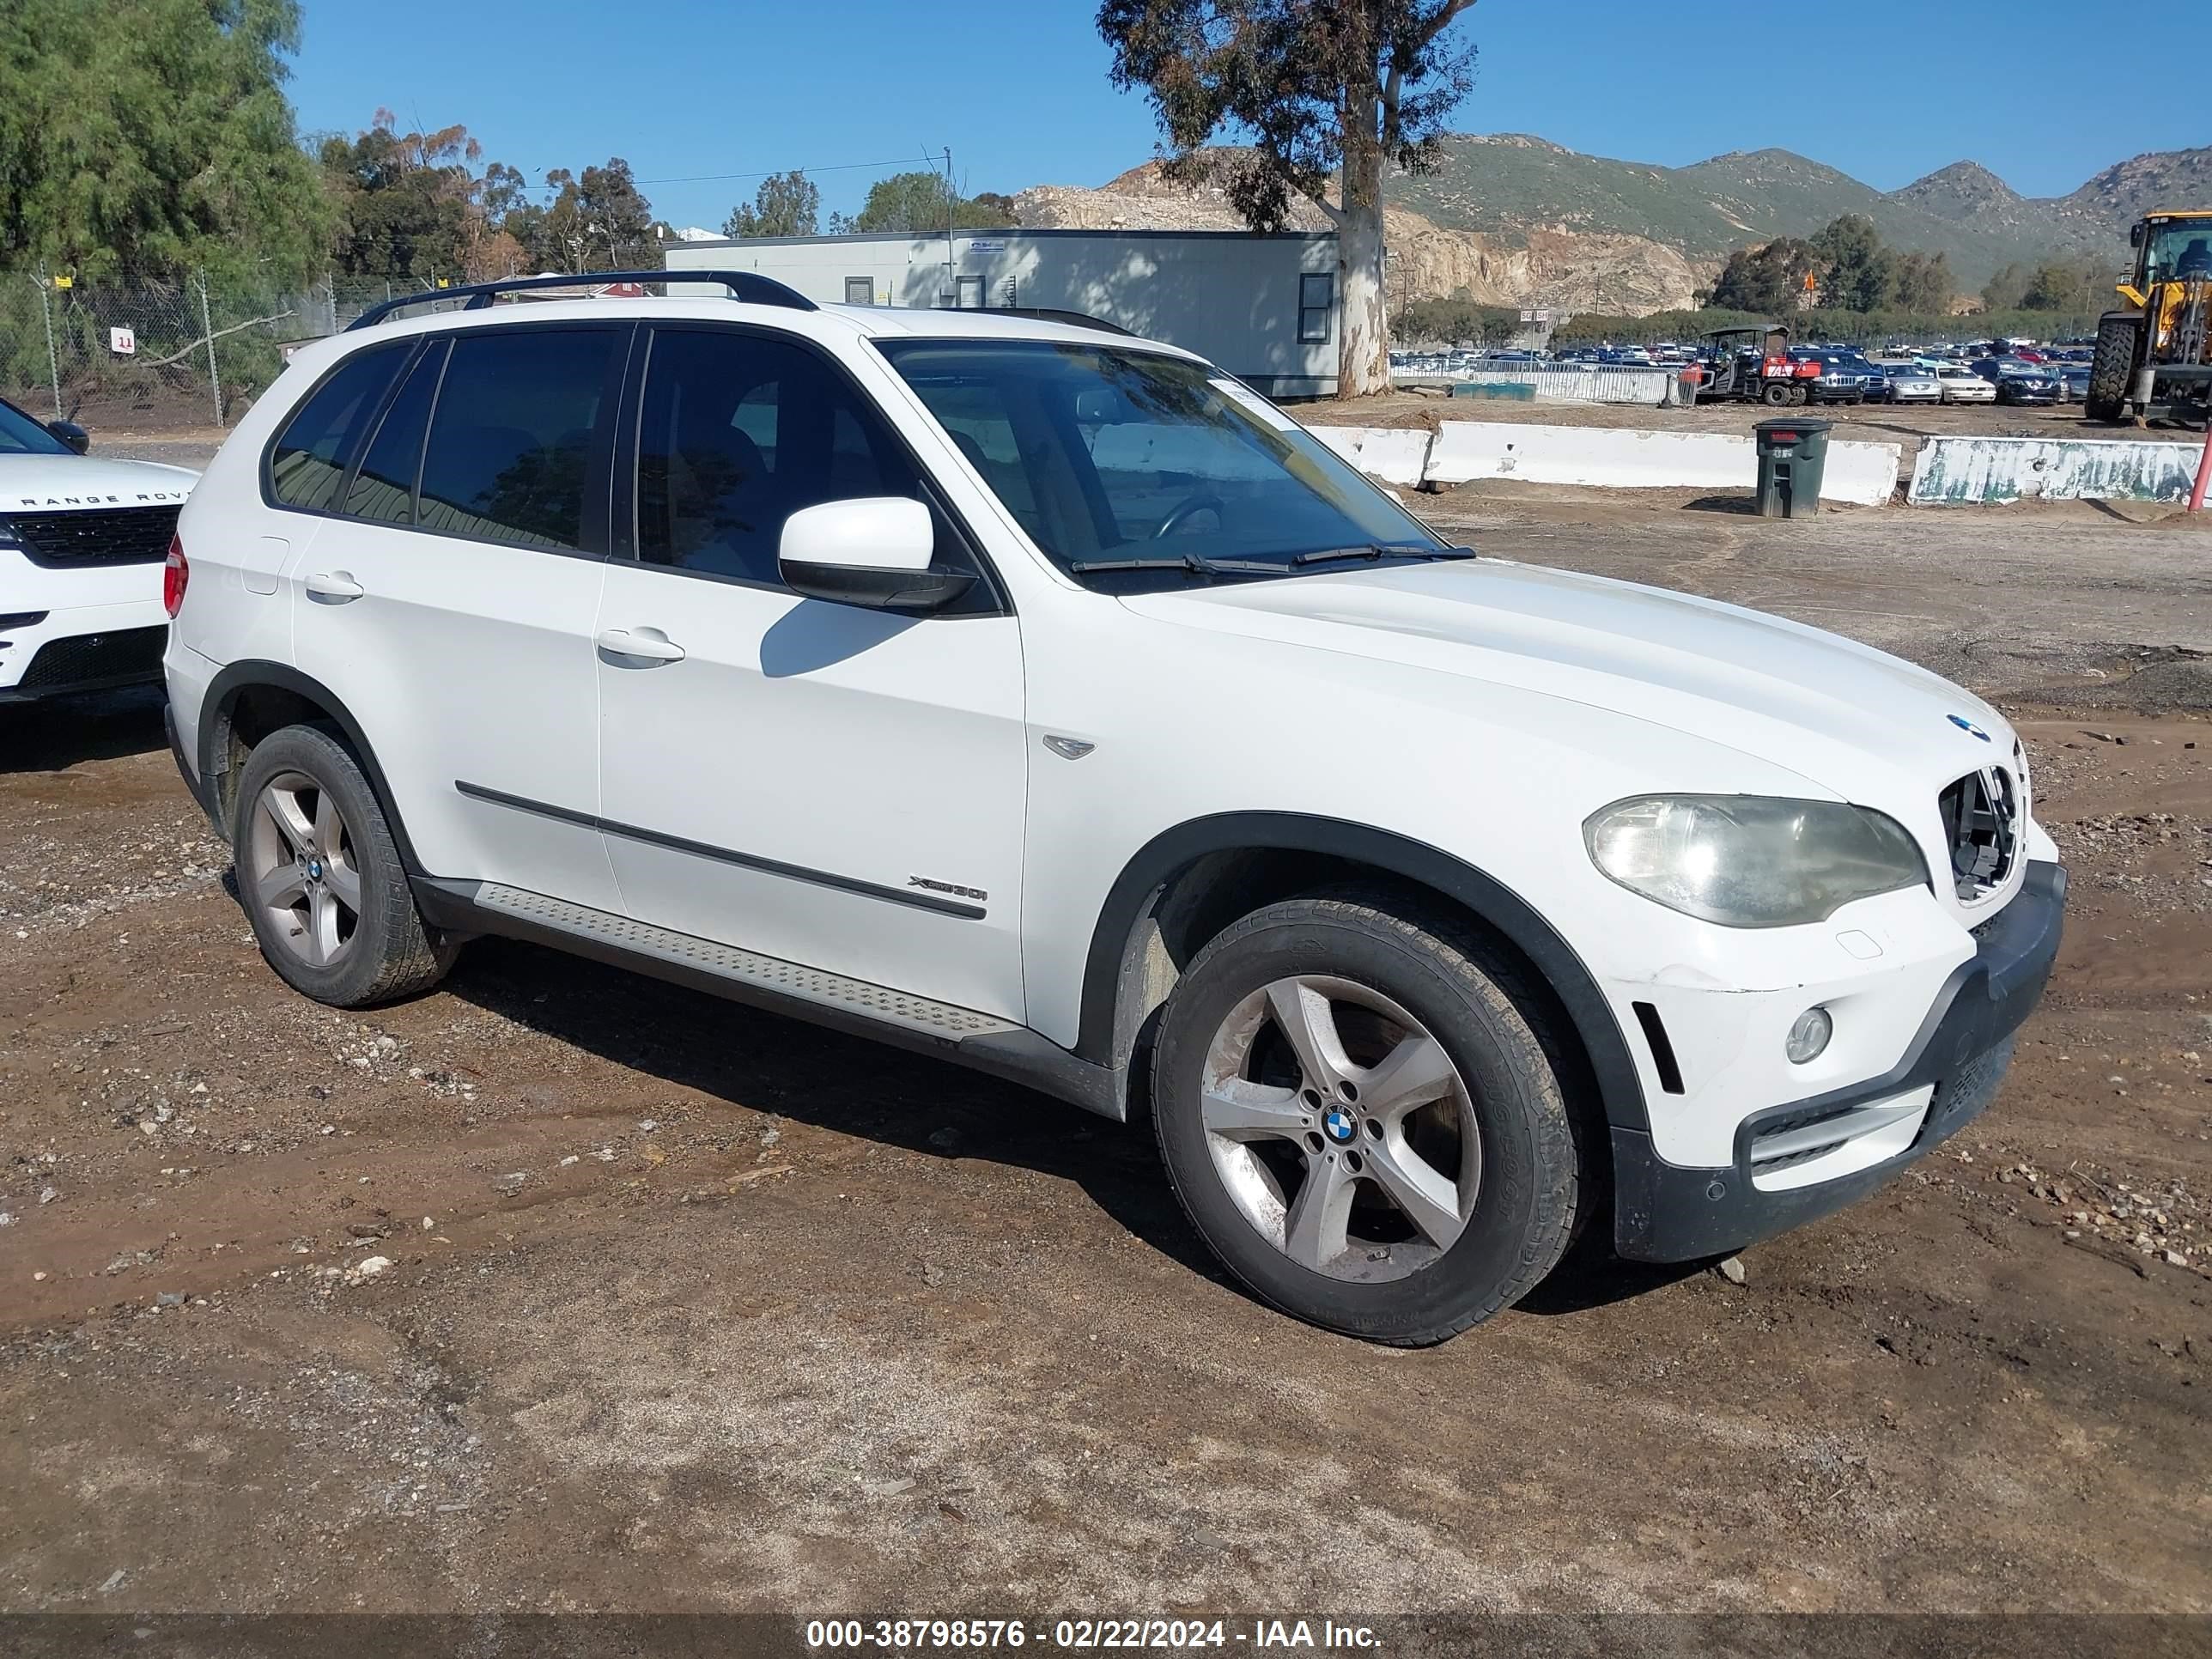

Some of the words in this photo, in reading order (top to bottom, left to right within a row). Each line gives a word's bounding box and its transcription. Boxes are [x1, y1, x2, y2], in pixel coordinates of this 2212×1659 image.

[21, 495, 120, 507] RANGE
[137, 492, 191, 501] ROV
[1325, 1105, 1357, 1123] BMW
